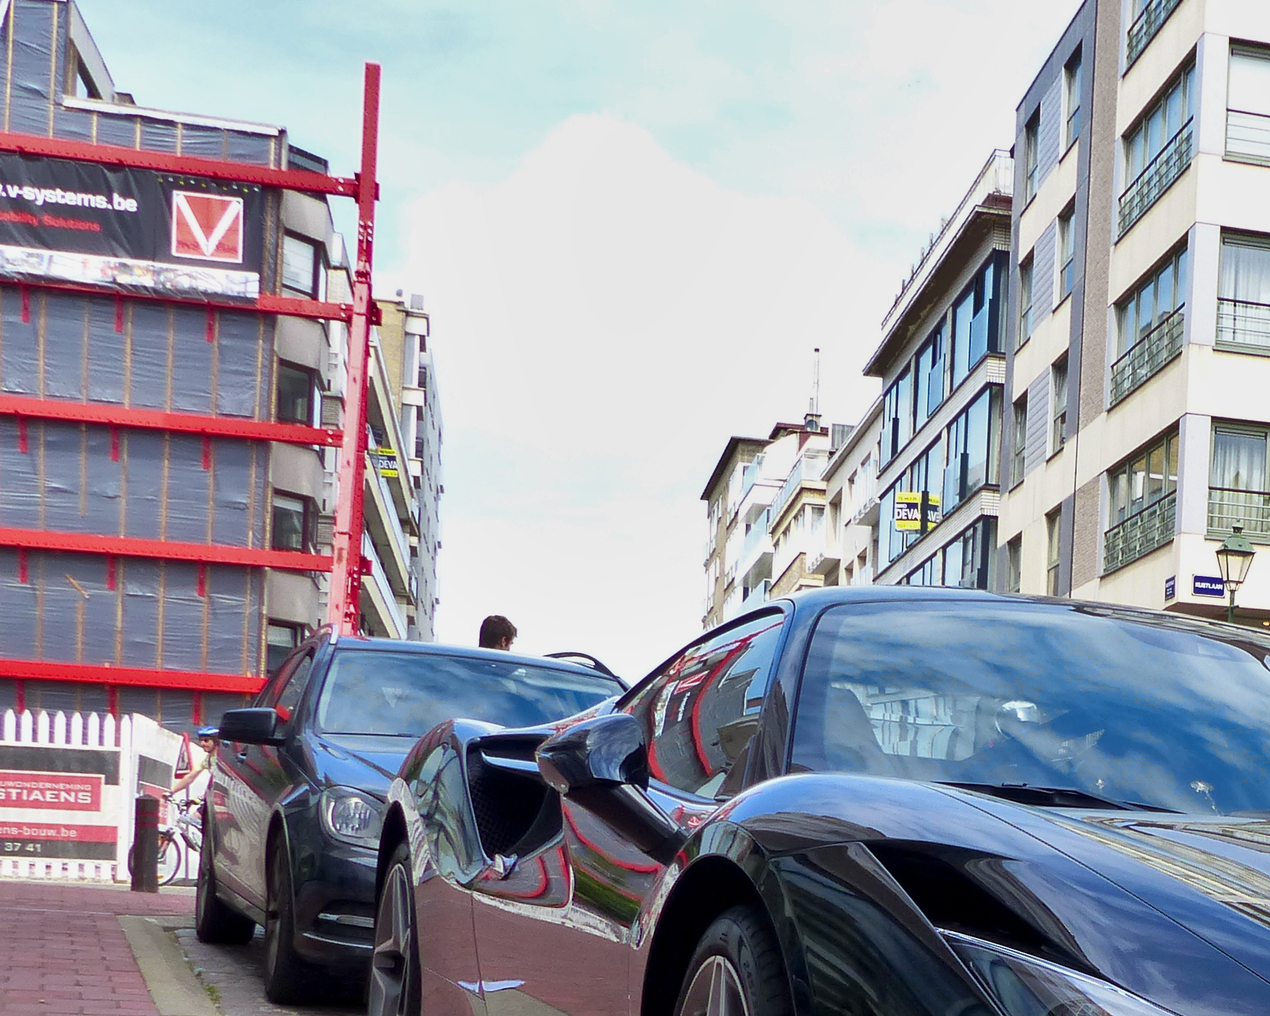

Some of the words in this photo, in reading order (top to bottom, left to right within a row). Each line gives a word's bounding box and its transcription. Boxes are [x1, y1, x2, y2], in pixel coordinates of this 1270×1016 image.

[0, 184, 138, 212] .v-systems.be
[896, 509, 921, 520] DEVA
[4, 842, 22, 852] 37
[25, 843, 42, 852] 41
